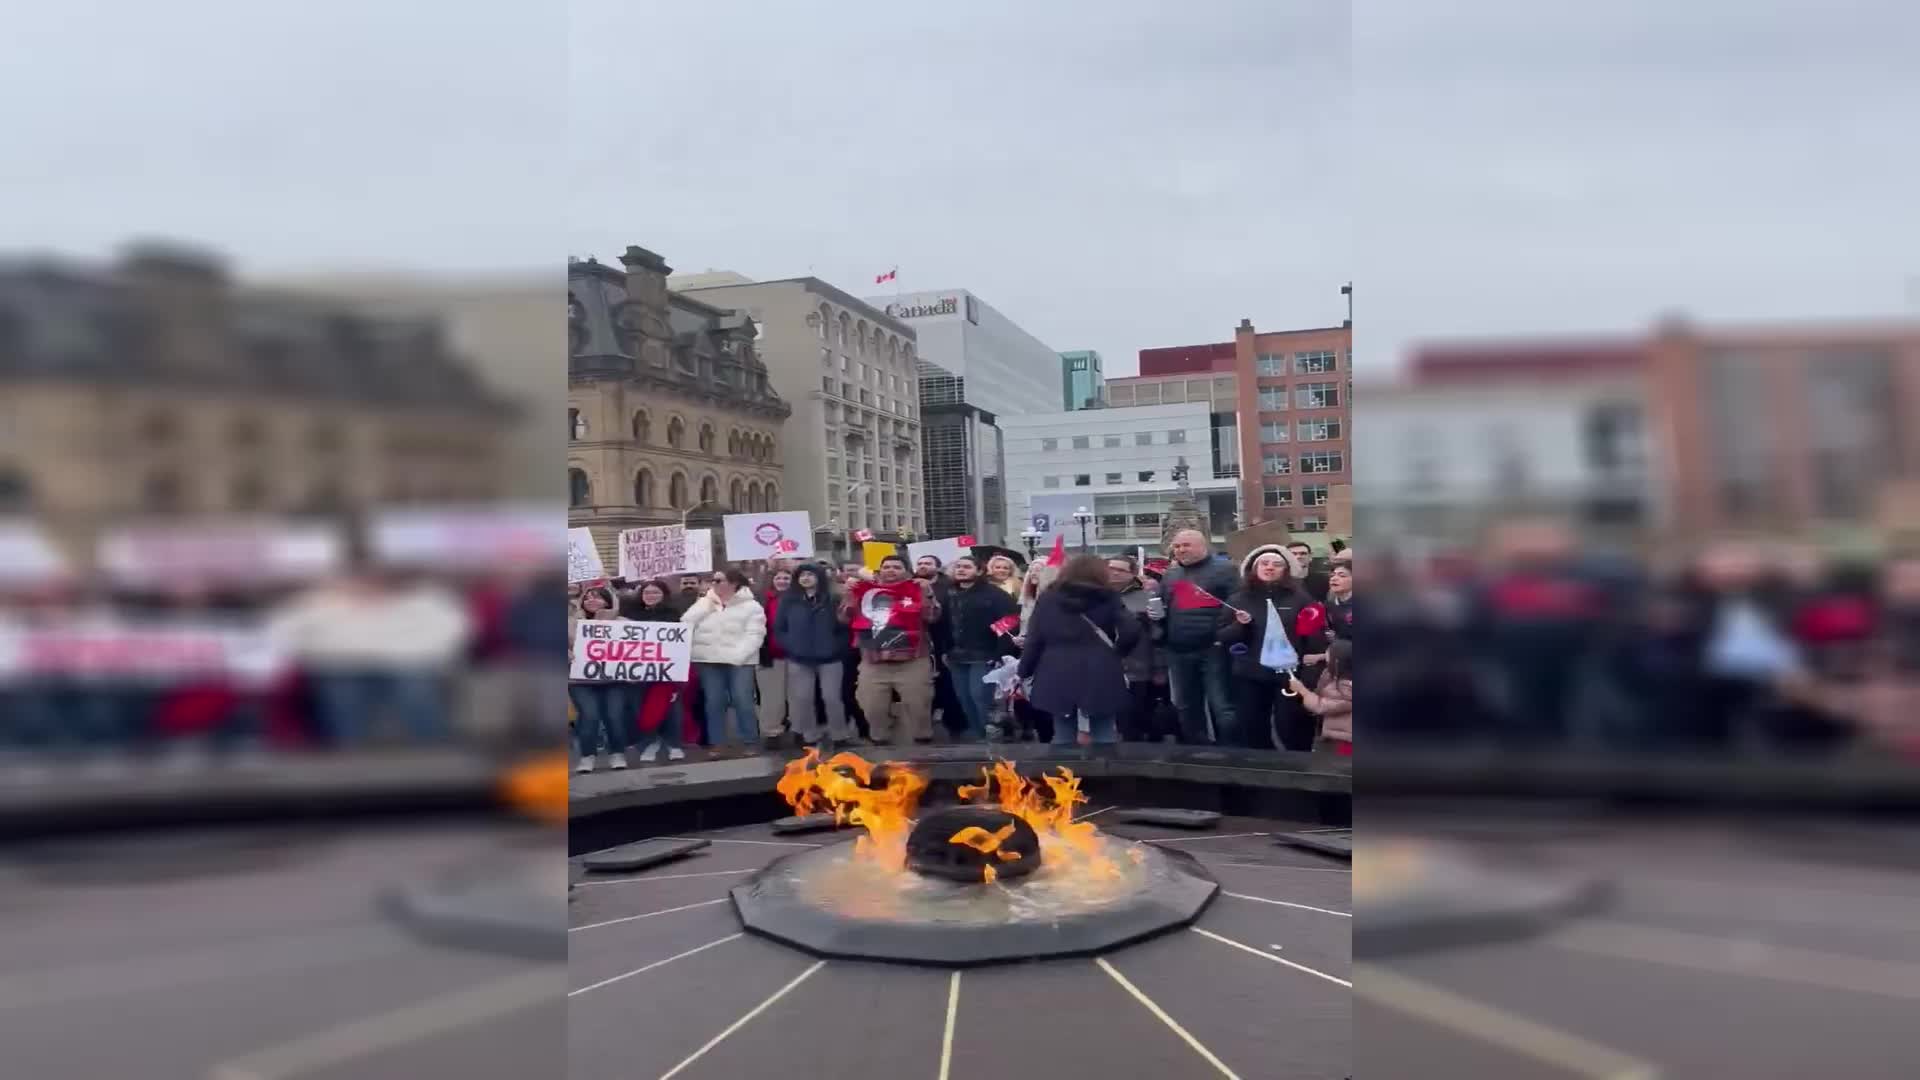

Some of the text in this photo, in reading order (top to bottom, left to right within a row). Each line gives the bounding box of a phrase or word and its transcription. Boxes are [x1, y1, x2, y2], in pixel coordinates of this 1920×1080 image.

[885, 297, 956, 318] Canada
[582, 624, 688, 643] HER SEY COK
[587, 639, 671, 662] GUZEL
[583, 661, 676, 681] OLACAK
